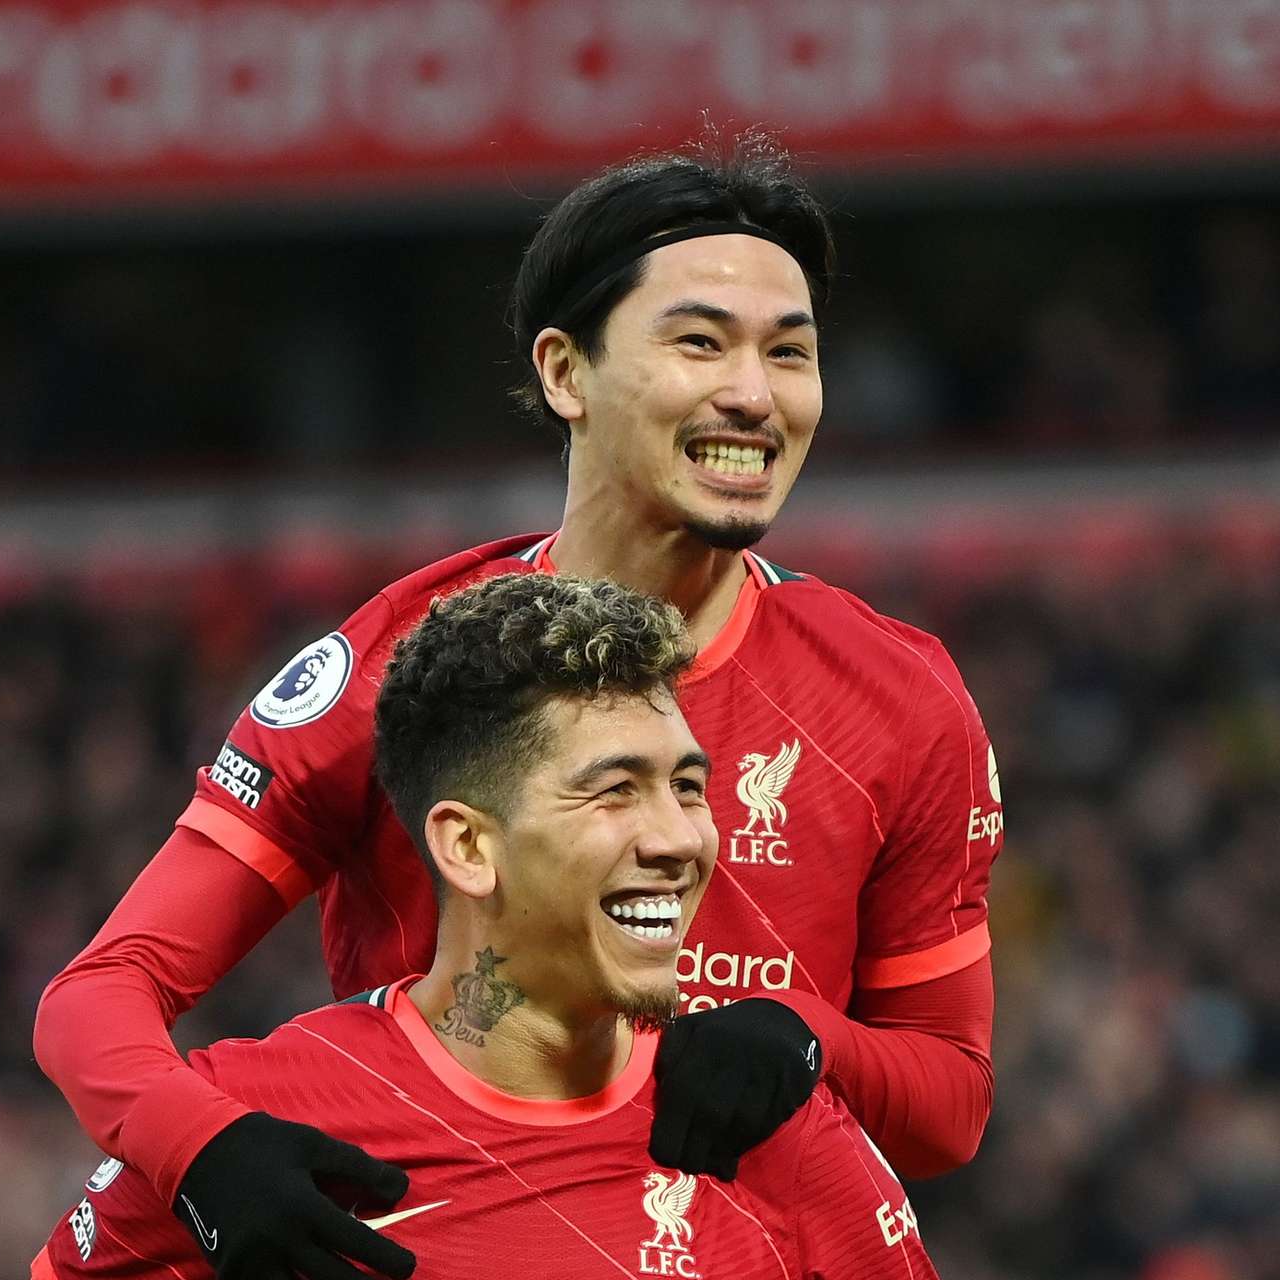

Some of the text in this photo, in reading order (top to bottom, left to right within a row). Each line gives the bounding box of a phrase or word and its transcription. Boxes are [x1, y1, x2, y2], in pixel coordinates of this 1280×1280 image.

[727, 837, 794, 866] L.F.C.
[675, 941, 795, 991] dard
[638, 1247, 704, 1280] L.F.C.
